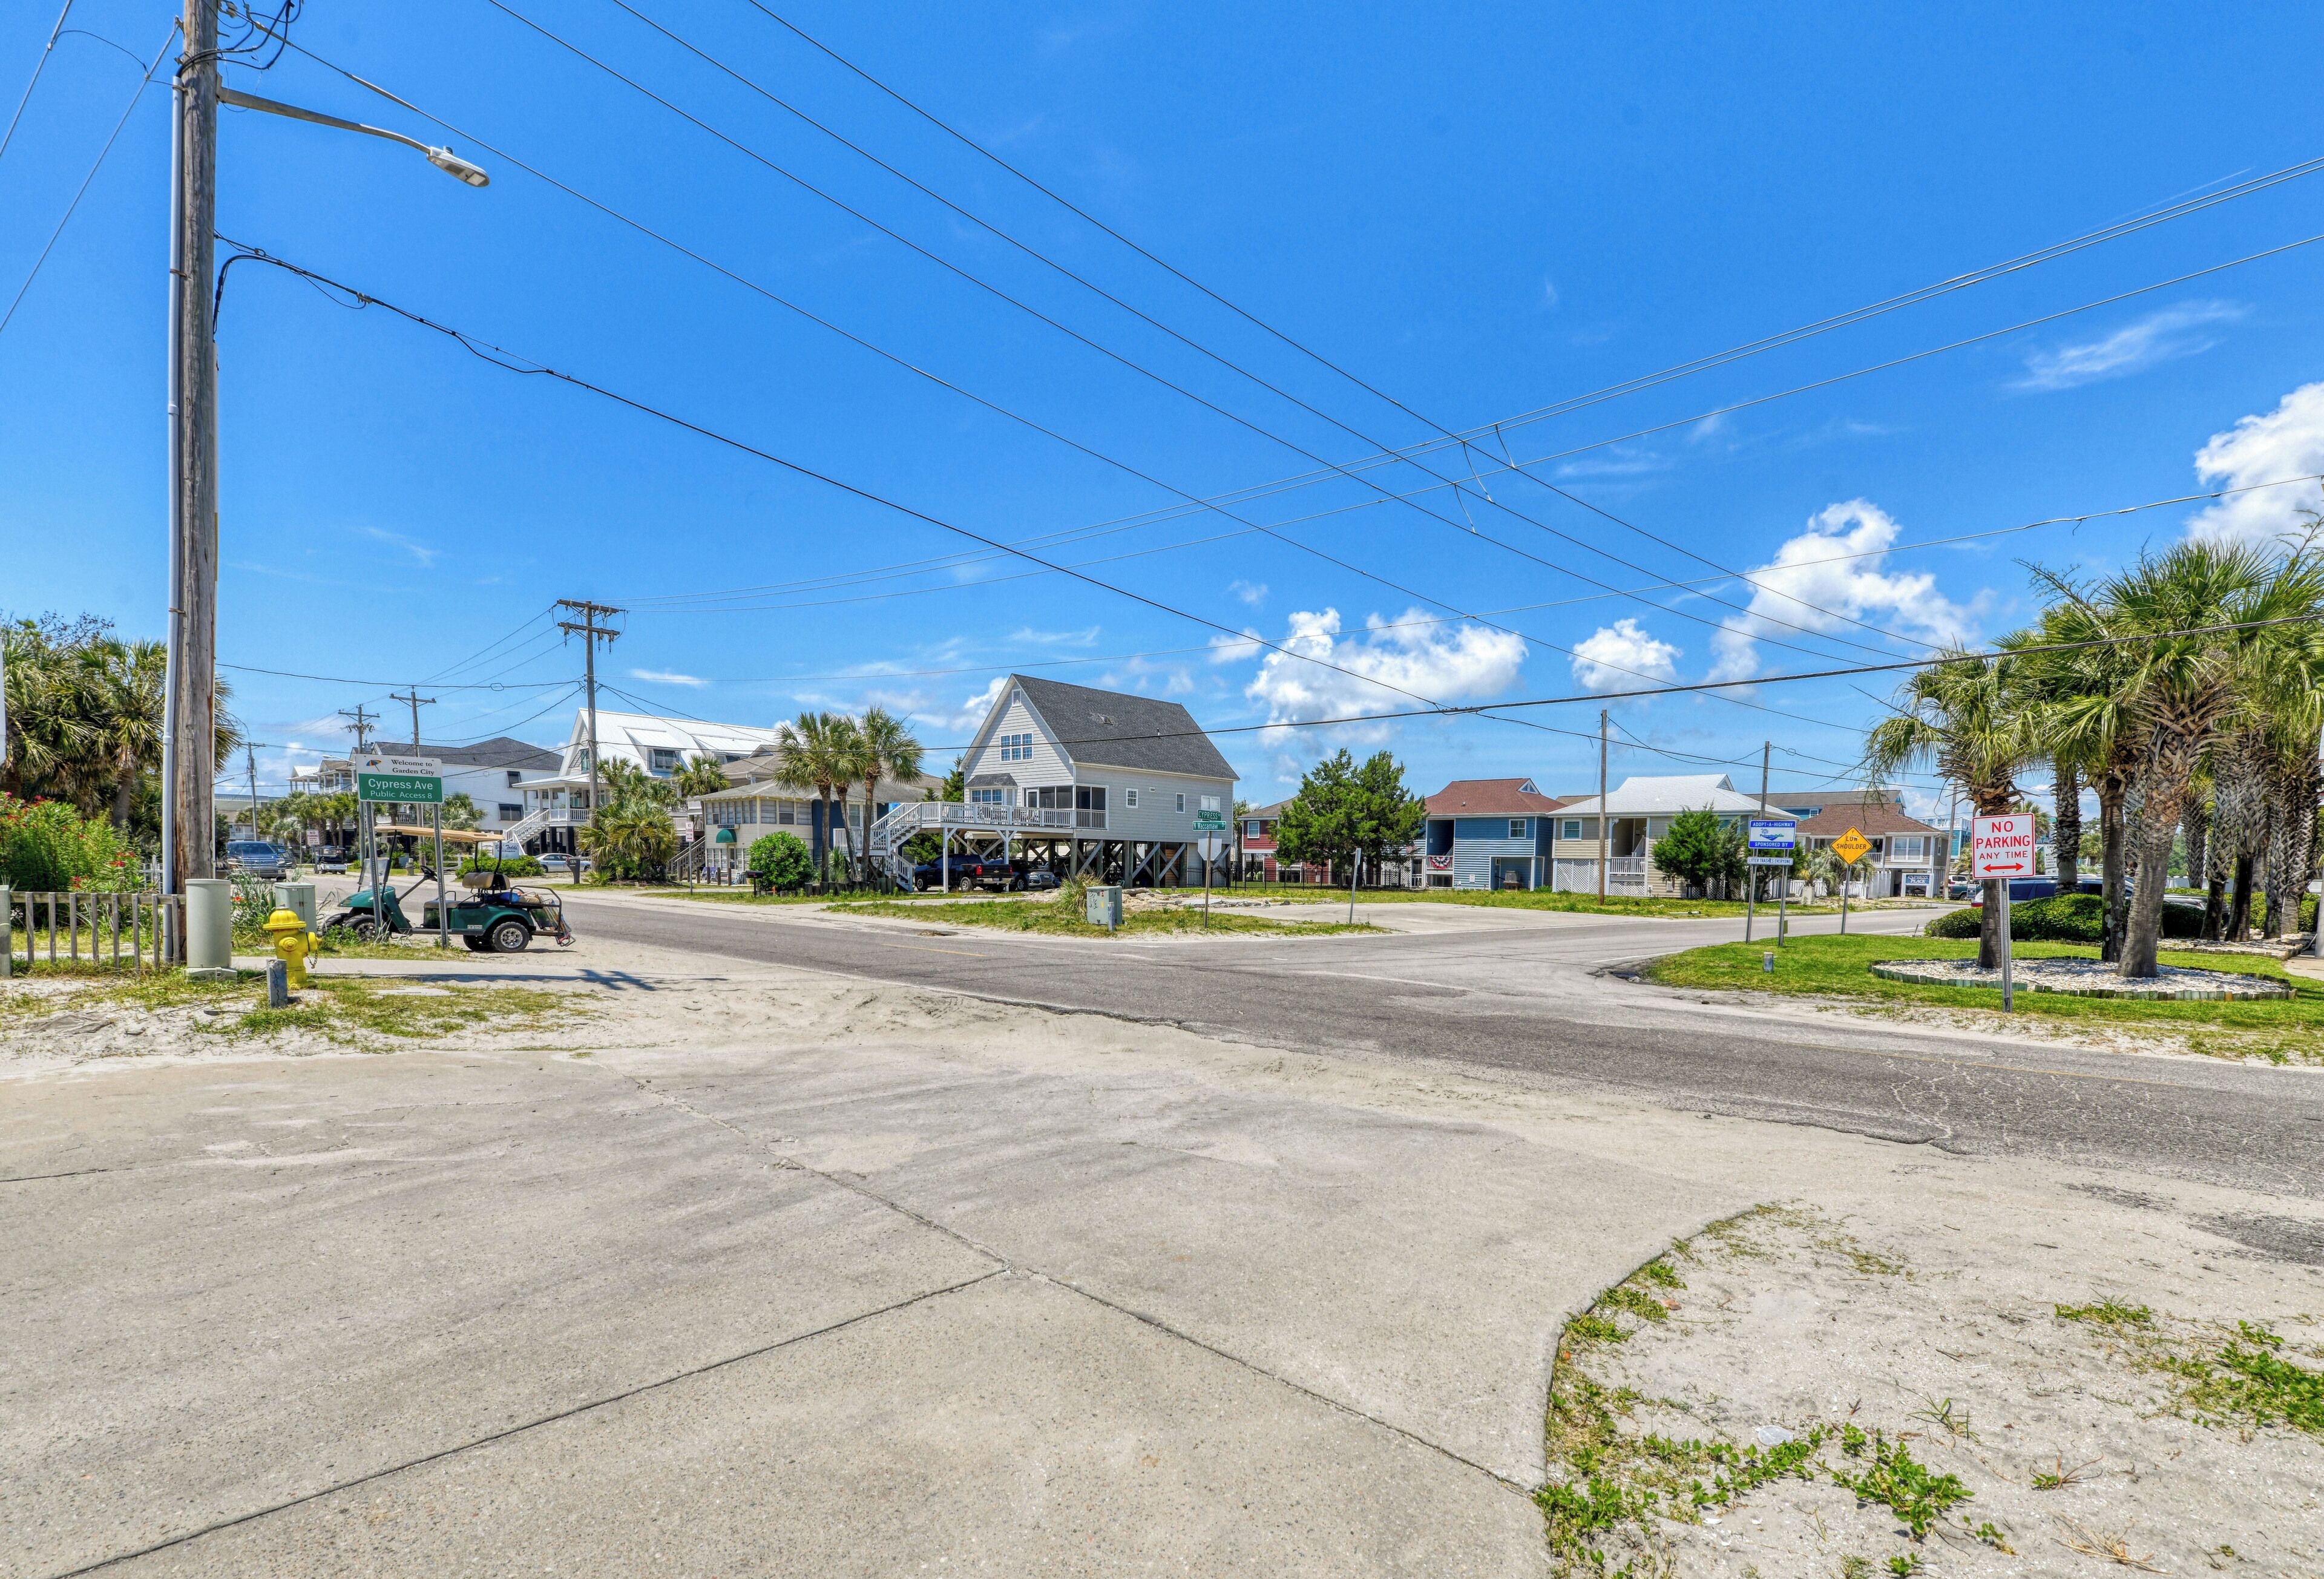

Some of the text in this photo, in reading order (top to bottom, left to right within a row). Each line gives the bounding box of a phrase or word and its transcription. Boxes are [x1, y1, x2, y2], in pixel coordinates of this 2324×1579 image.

[368, 778, 433, 790] Cypress Ave
[1198, 811, 1218, 819] CYPRESS
[1992, 821, 2014, 833] NO
[1976, 835, 2030, 849] PARKING
